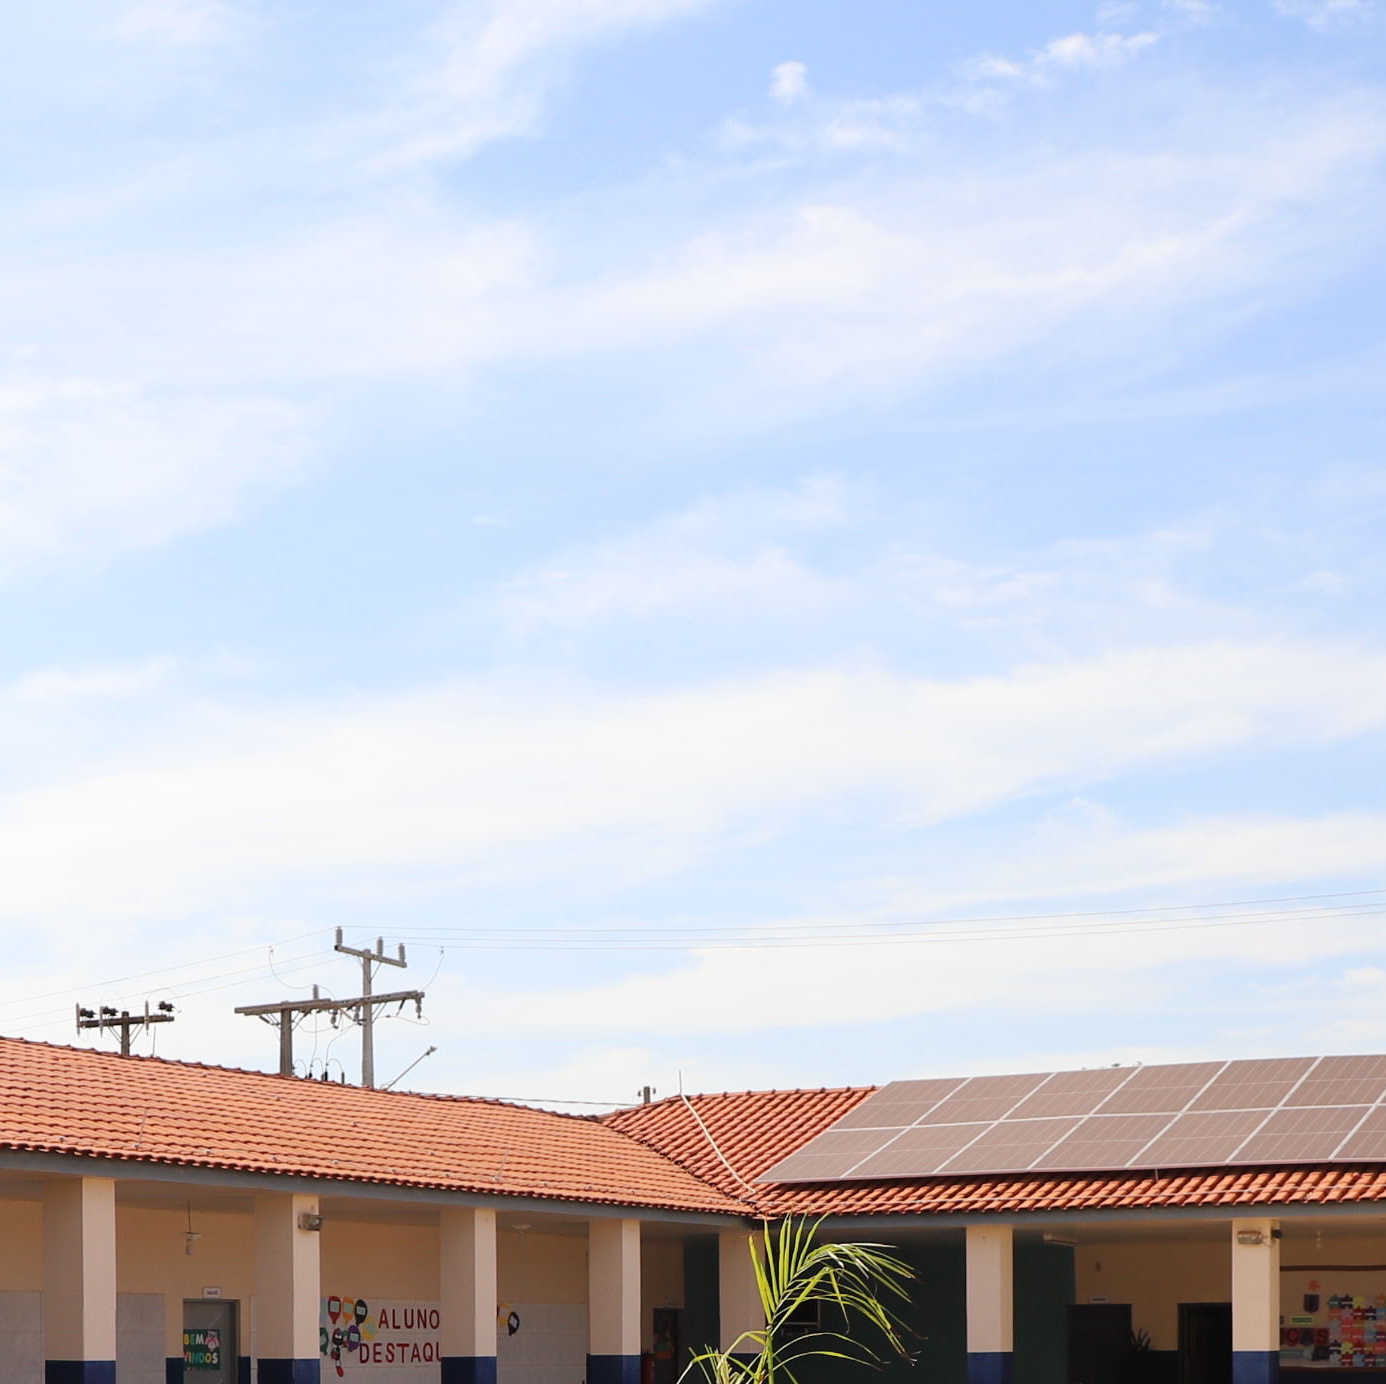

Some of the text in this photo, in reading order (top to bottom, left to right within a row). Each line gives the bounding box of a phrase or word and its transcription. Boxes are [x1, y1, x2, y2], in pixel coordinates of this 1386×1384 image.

[378, 1308, 440, 1330] ALUNO
[183, 1333, 204, 1345] BEM
[183, 1351, 218, 1364] VINDOS
